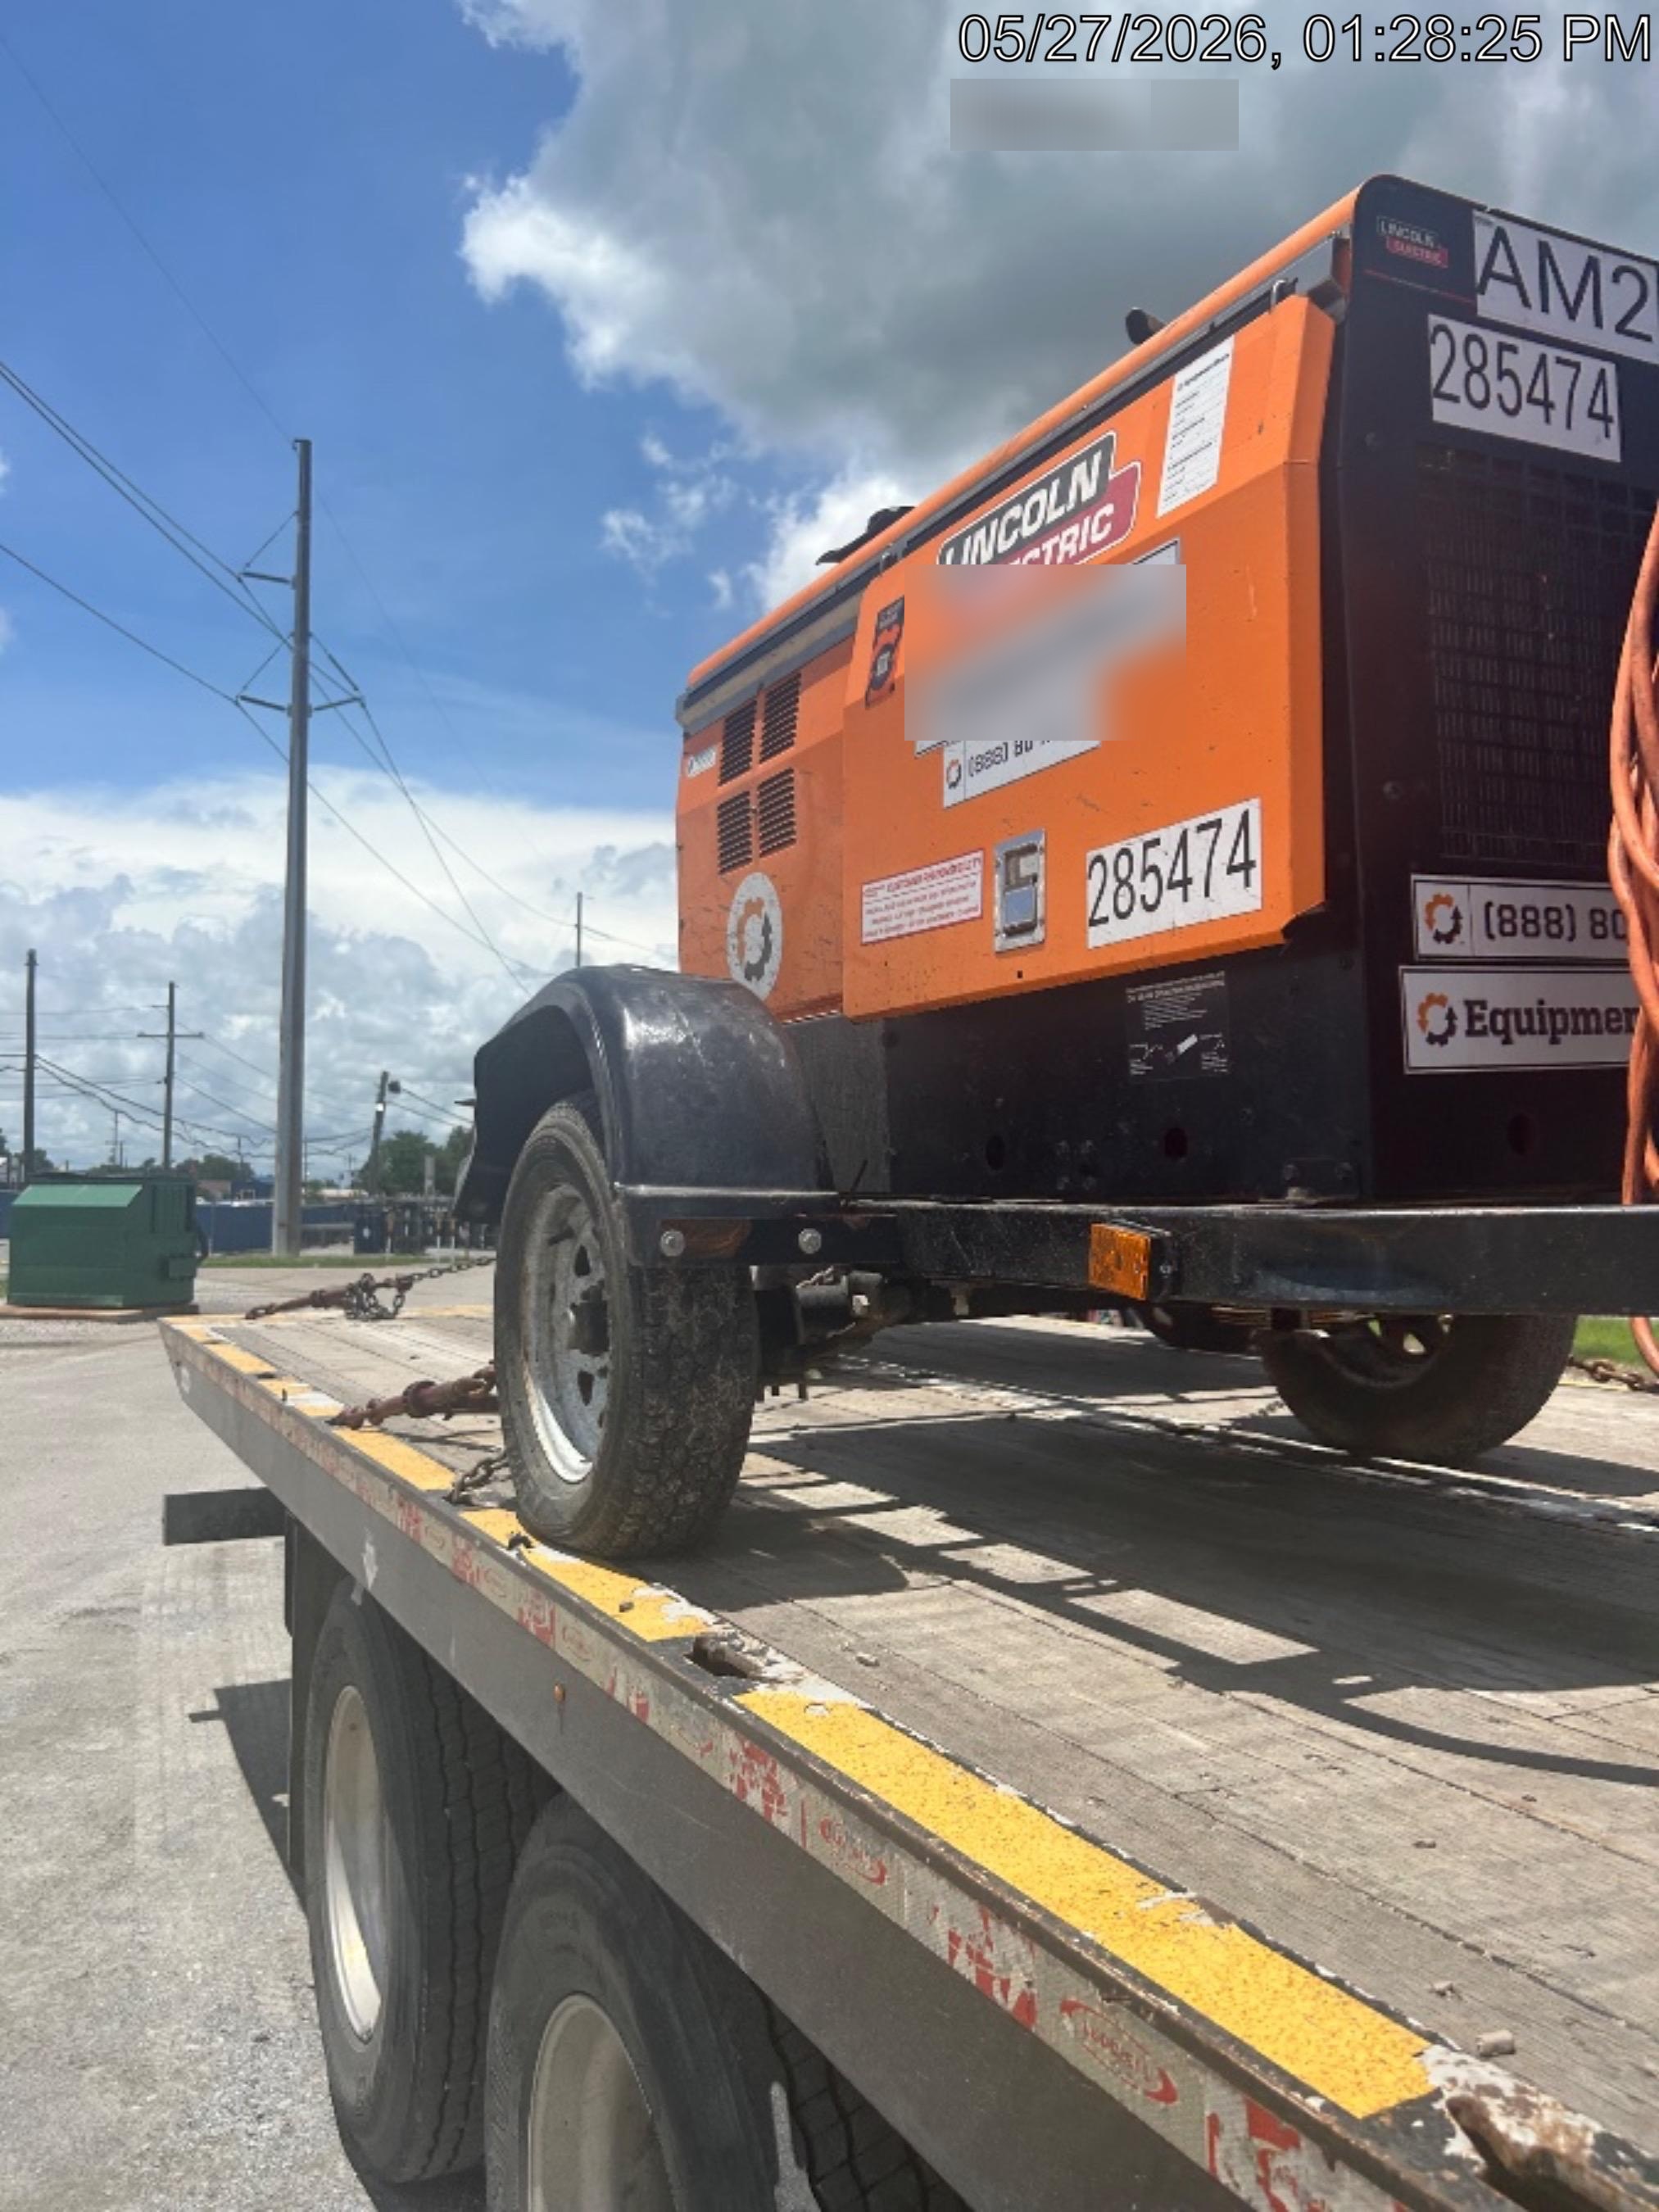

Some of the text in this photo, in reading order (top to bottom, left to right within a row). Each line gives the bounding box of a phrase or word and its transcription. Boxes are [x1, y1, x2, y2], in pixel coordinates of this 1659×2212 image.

[1476, 225, 1652, 342] AM2
[1430, 324, 1614, 438] 285474
[1089, 809, 1256, 927] 285474
[1484, 901, 1577, 941] (888)
